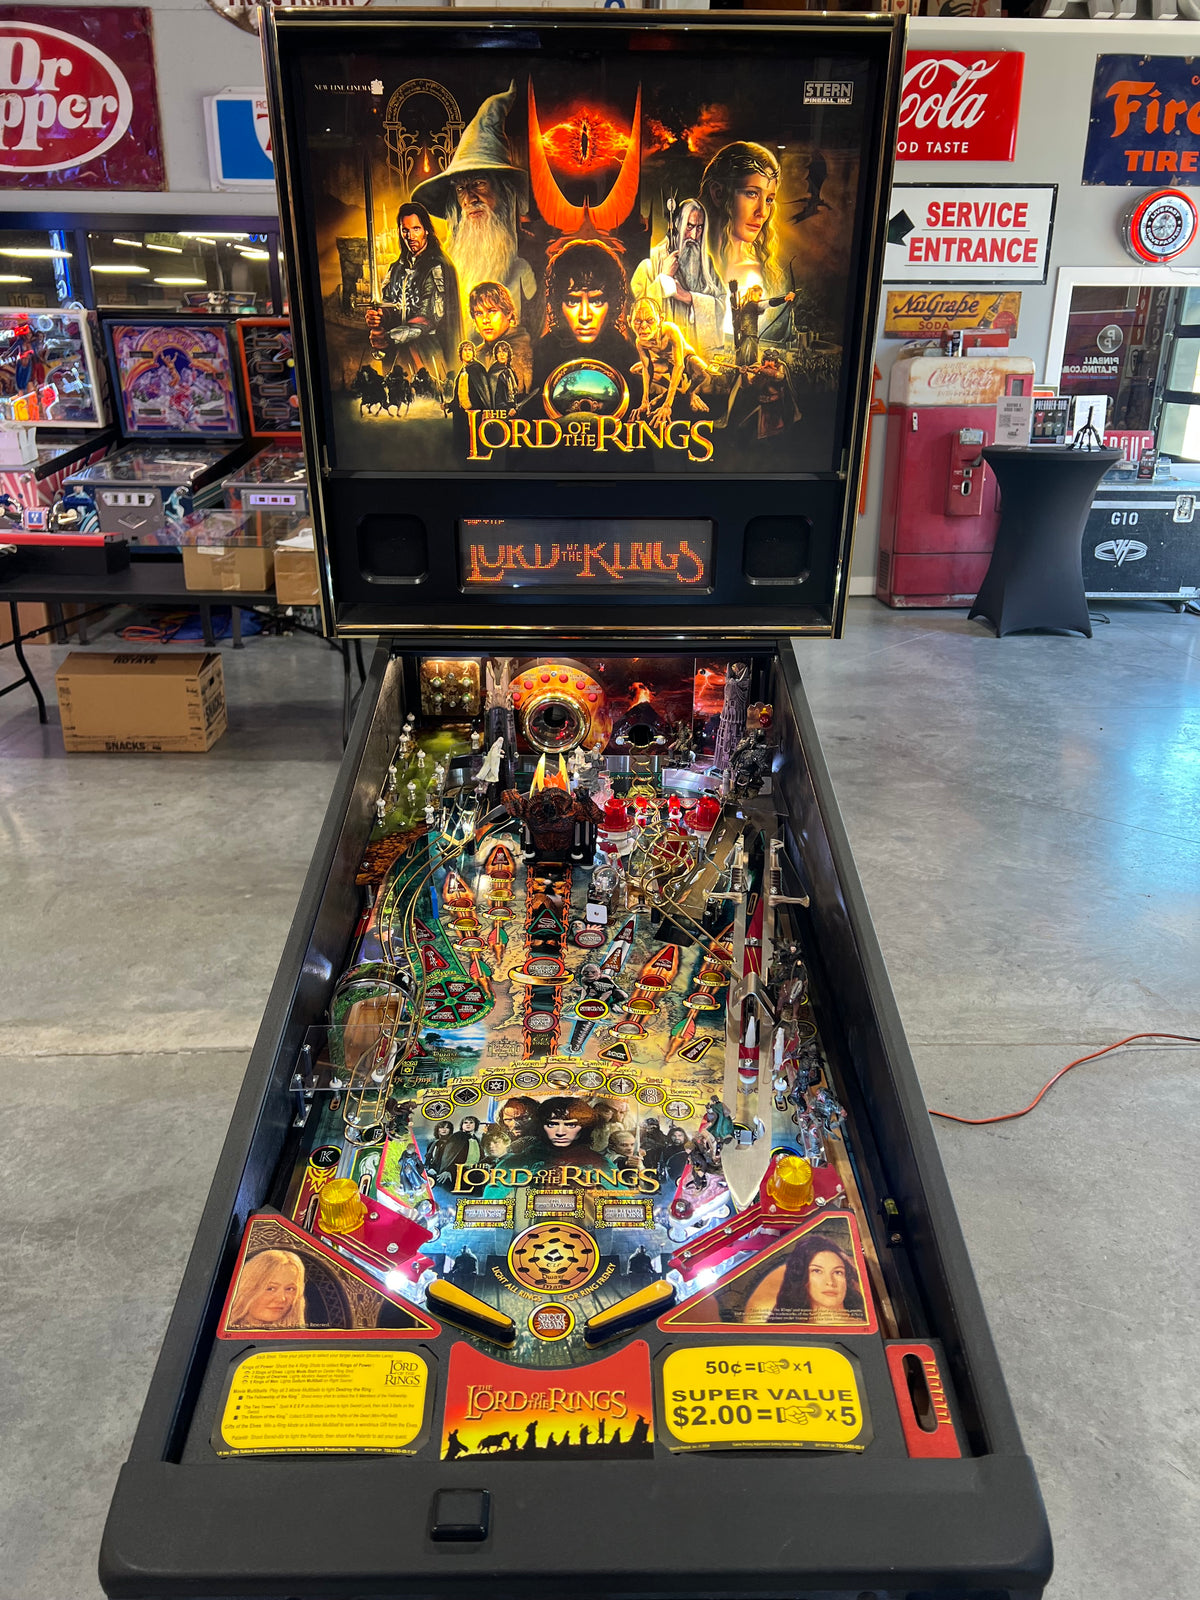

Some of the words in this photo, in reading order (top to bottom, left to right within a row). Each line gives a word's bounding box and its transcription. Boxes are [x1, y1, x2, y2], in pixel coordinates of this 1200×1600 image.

[0, 37, 73, 91] Dr
[806, 83, 852, 97] STERN
[926, 142, 969, 153] TASTE
[1124, 151, 1198, 172] TIRE
[926, 201, 1029, 228] SERVICE
[908, 236, 1039, 263] ENTRANCE
[893, 293, 980, 314] NuGrape
[918, 322, 950, 330] SODA
[482, 409, 507, 420] THE
[465, 409, 563, 461] LORD
[568, 421, 592, 435] OF
[562, 434, 597, 448] THE
[592, 415, 714, 462] RINGS
[1111, 511, 1139, 526] G10
[434, 663, 440, 674] 1
[462, 665, 470, 675] 2
[105, 741, 146, 751] SNACKS
[319, 1150, 334, 1163] K
[452, 1163, 533, 1194] LORD
[533, 1176, 560, 1185] THE
[539, 1170, 558, 1179] OF
[559, 1165, 660, 1194] RINGS
[491, 1265, 509, 1286] LIGHT
[504, 1282, 518, 1295] ALL
[517, 1290, 543, 1302] RINGS
[563, 1292, 580, 1302] FOR
[580, 1280, 600, 1297] RING
[596, 1261, 617, 1286] FRENZY
[537, 1312, 566, 1321] SHOOT
[539, 1320, 566, 1330] AGAIN
[390, 1359, 419, 1375] LORD
[706, 1360, 741, 1377] 50¢
[384, 1374, 421, 1386] RINGS
[464, 1385, 527, 1419] LORD
[531, 1392, 545, 1400] OF
[548, 1387, 627, 1418] RINGS
[672, 1390, 759, 1402] SUPER
[768, 1389, 853, 1402] VALUE
[528, 1400, 549, 1410] THE
[673, 1405, 753, 1430] $2.00
